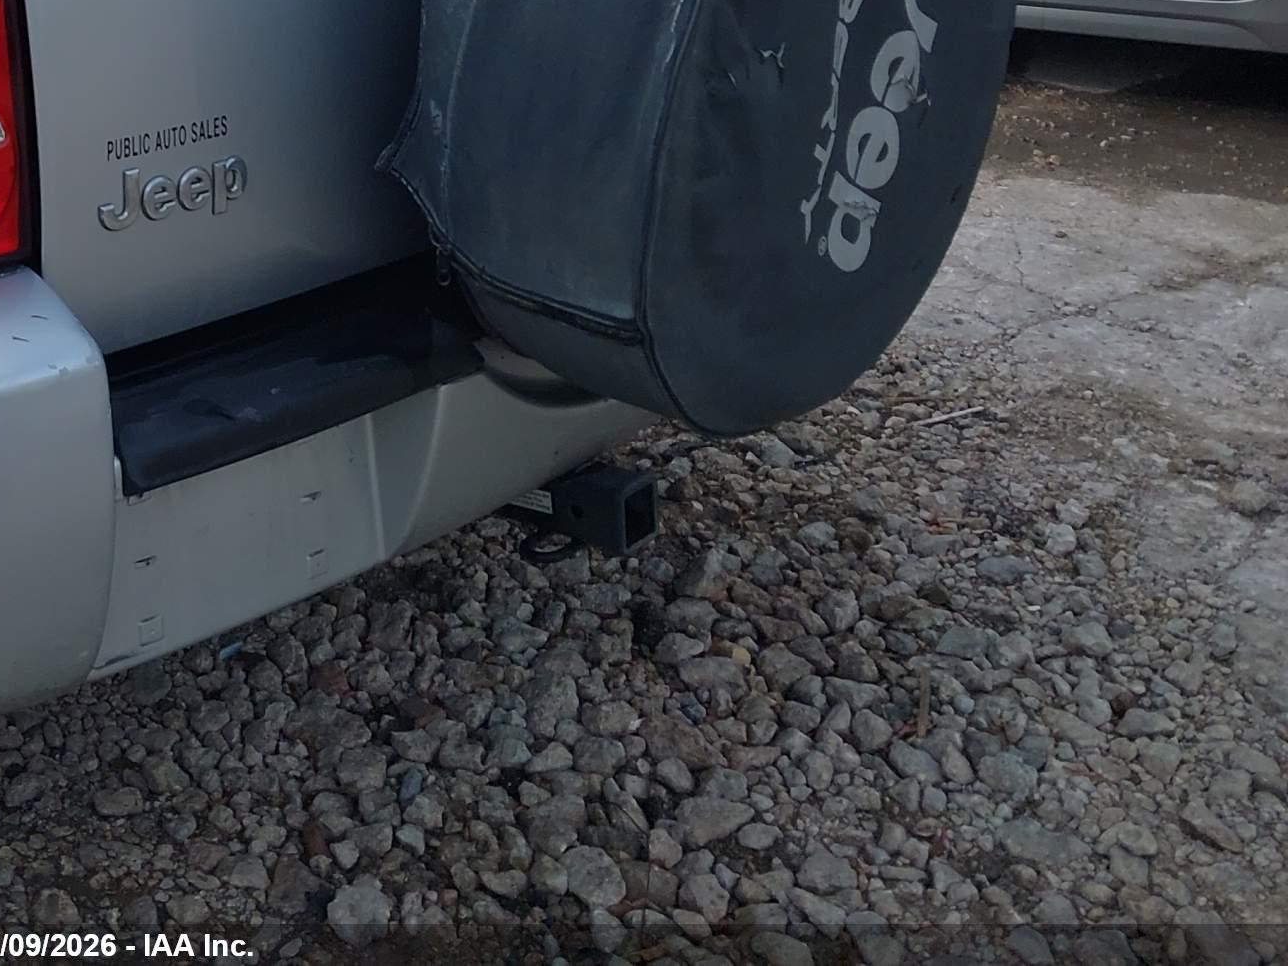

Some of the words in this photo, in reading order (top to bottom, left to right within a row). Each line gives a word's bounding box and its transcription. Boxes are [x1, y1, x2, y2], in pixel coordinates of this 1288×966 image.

[107, 133, 151, 162] PUBLIC
[155, 125, 187, 151] AUTO
[191, 115, 228, 143] SALES
[97, 155, 248, 232] Jeep
